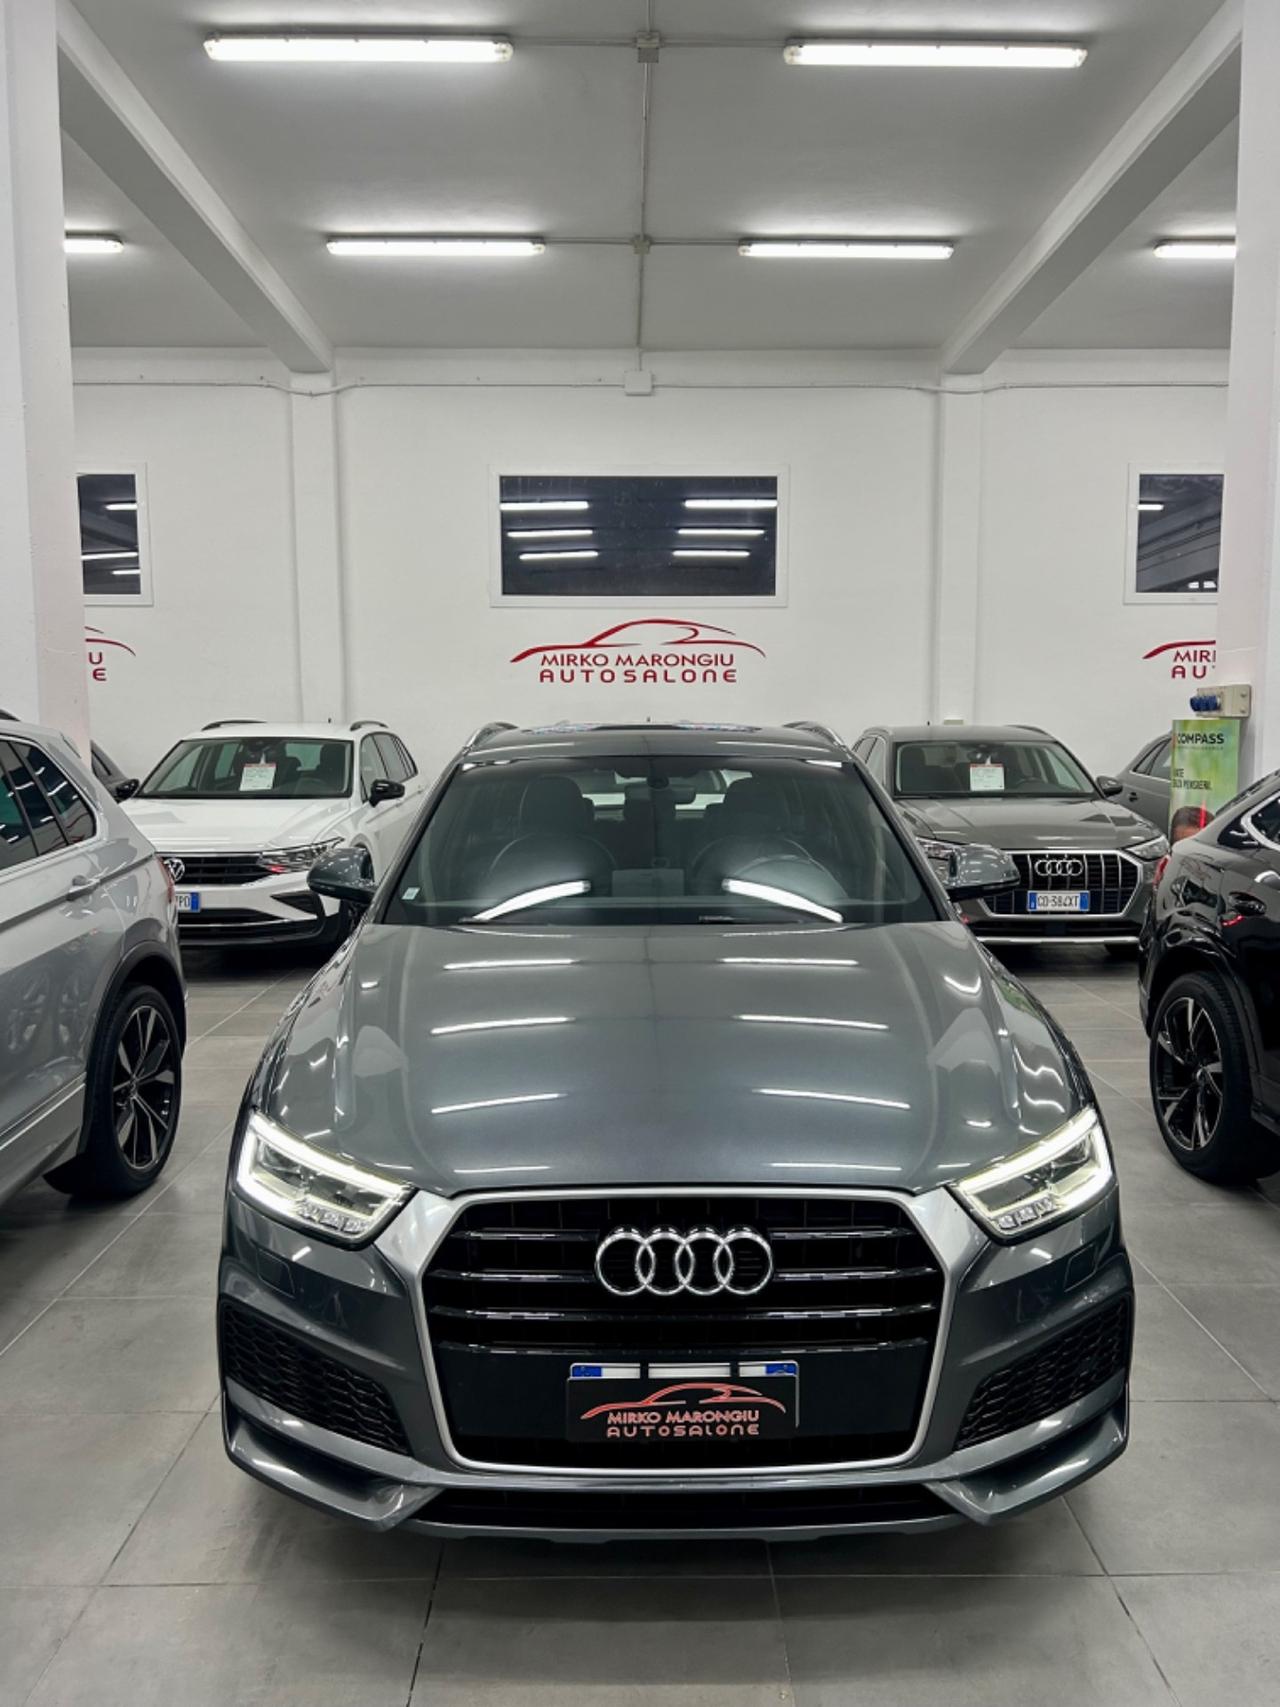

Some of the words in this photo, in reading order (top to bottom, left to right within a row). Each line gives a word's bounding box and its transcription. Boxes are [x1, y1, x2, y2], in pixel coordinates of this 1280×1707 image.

[541, 653, 609, 666] MIRKO
[615, 653, 735, 666] MARONGIU
[1172, 650, 1216, 662] MIR
[539, 668, 737, 683] AUTOSALONE
[1176, 733, 1225, 745] COMPASS
[607, 1410, 661, 1425] MIRKO
[665, 1409, 760, 1424] MARONGIU
[607, 1423, 760, 1438] AUTOSALONE
